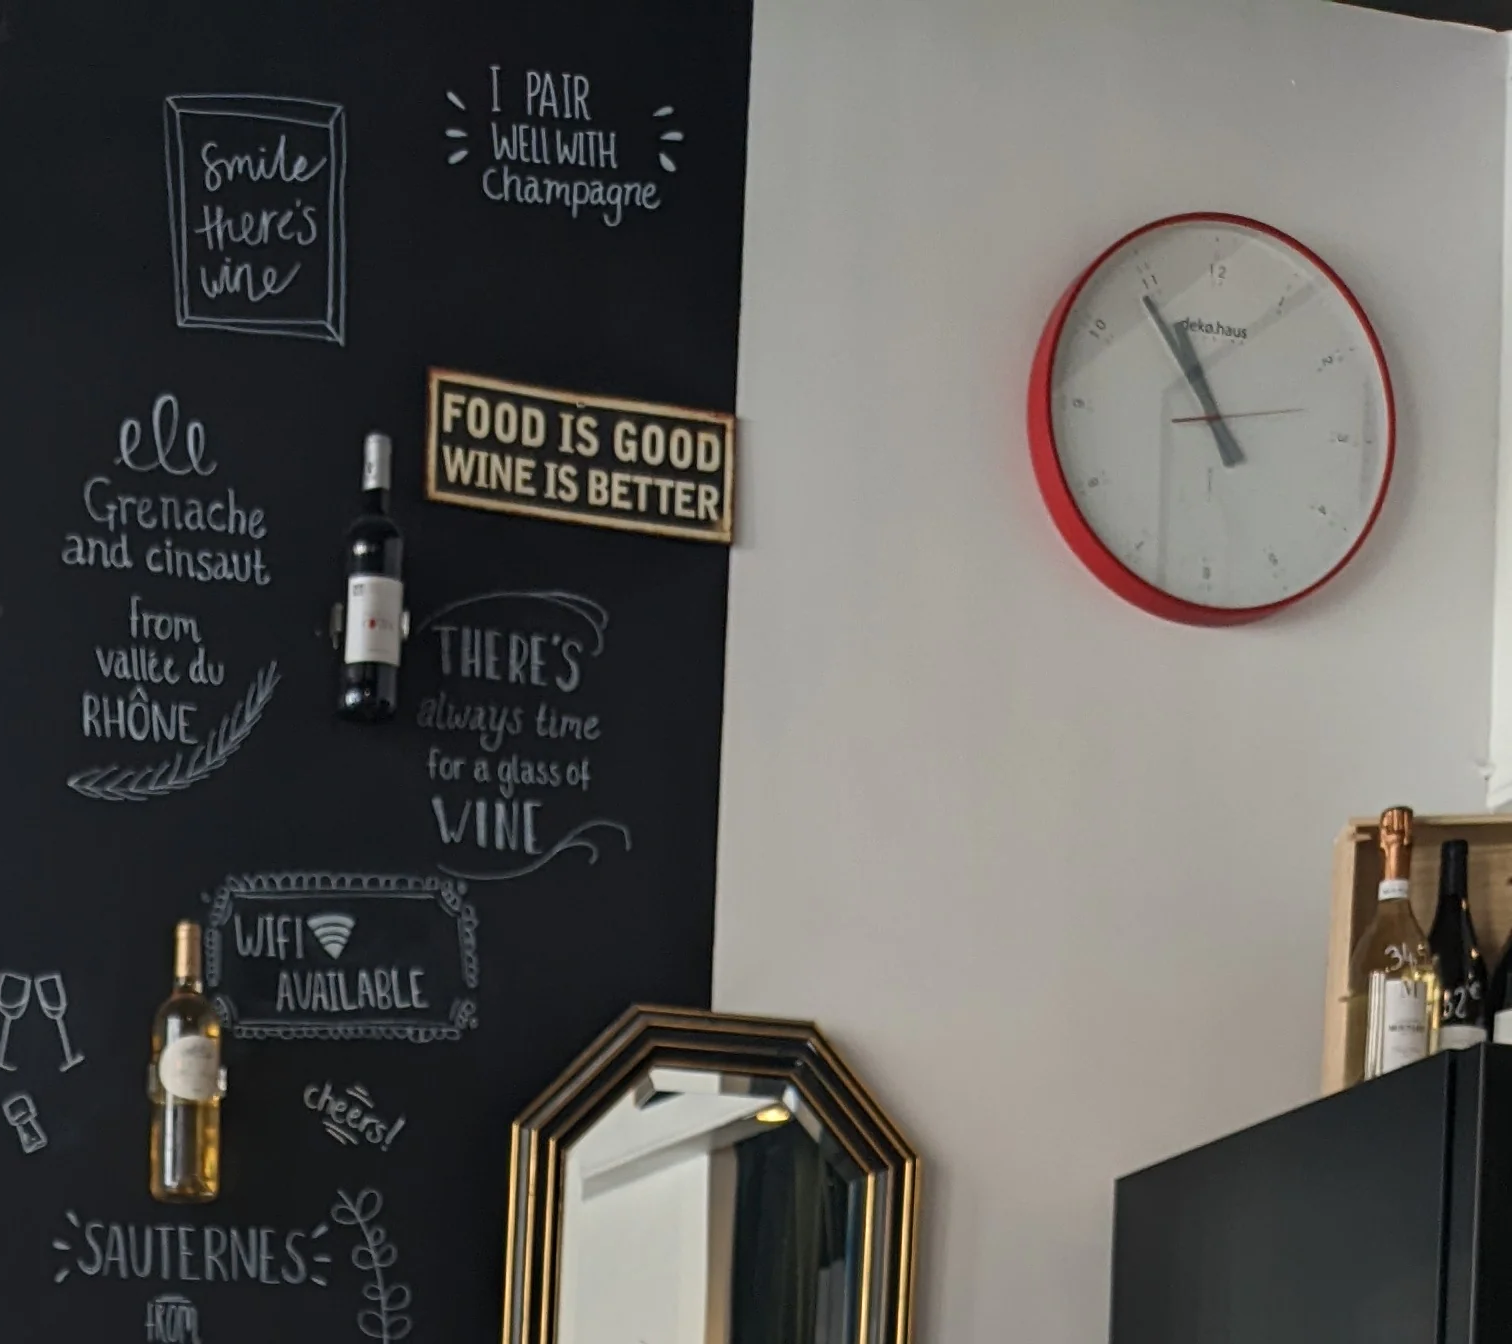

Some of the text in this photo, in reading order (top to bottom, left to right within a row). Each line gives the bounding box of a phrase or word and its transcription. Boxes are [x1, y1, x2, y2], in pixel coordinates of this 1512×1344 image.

[489, 64, 592, 121] I PAIR
[194, 199, 317, 251] there's
[1209, 263, 1227, 280] 12
[443, 392, 720, 471] FOOD IS GOOD
[83, 476, 267, 541] Grenache
[440, 444, 718, 523] WINE IS BETTER
[61, 533, 271, 586] and cinsaut
[129, 595, 202, 644] from
[189, 645, 225, 686] du
[433, 625, 583, 693] THERE'S
[82, 687, 198, 745] RHÔNE
[417, 697, 601, 753] always time
[427, 747, 591, 799] for a glass of
[431, 796, 542, 855] WINE
[234, 914, 304, 961] WIFI
[276, 967, 429, 1012] AVAILABLE
[303, 1083, 406, 1152] cheers!
[76, 1221, 307, 1285] SAUTERNES
